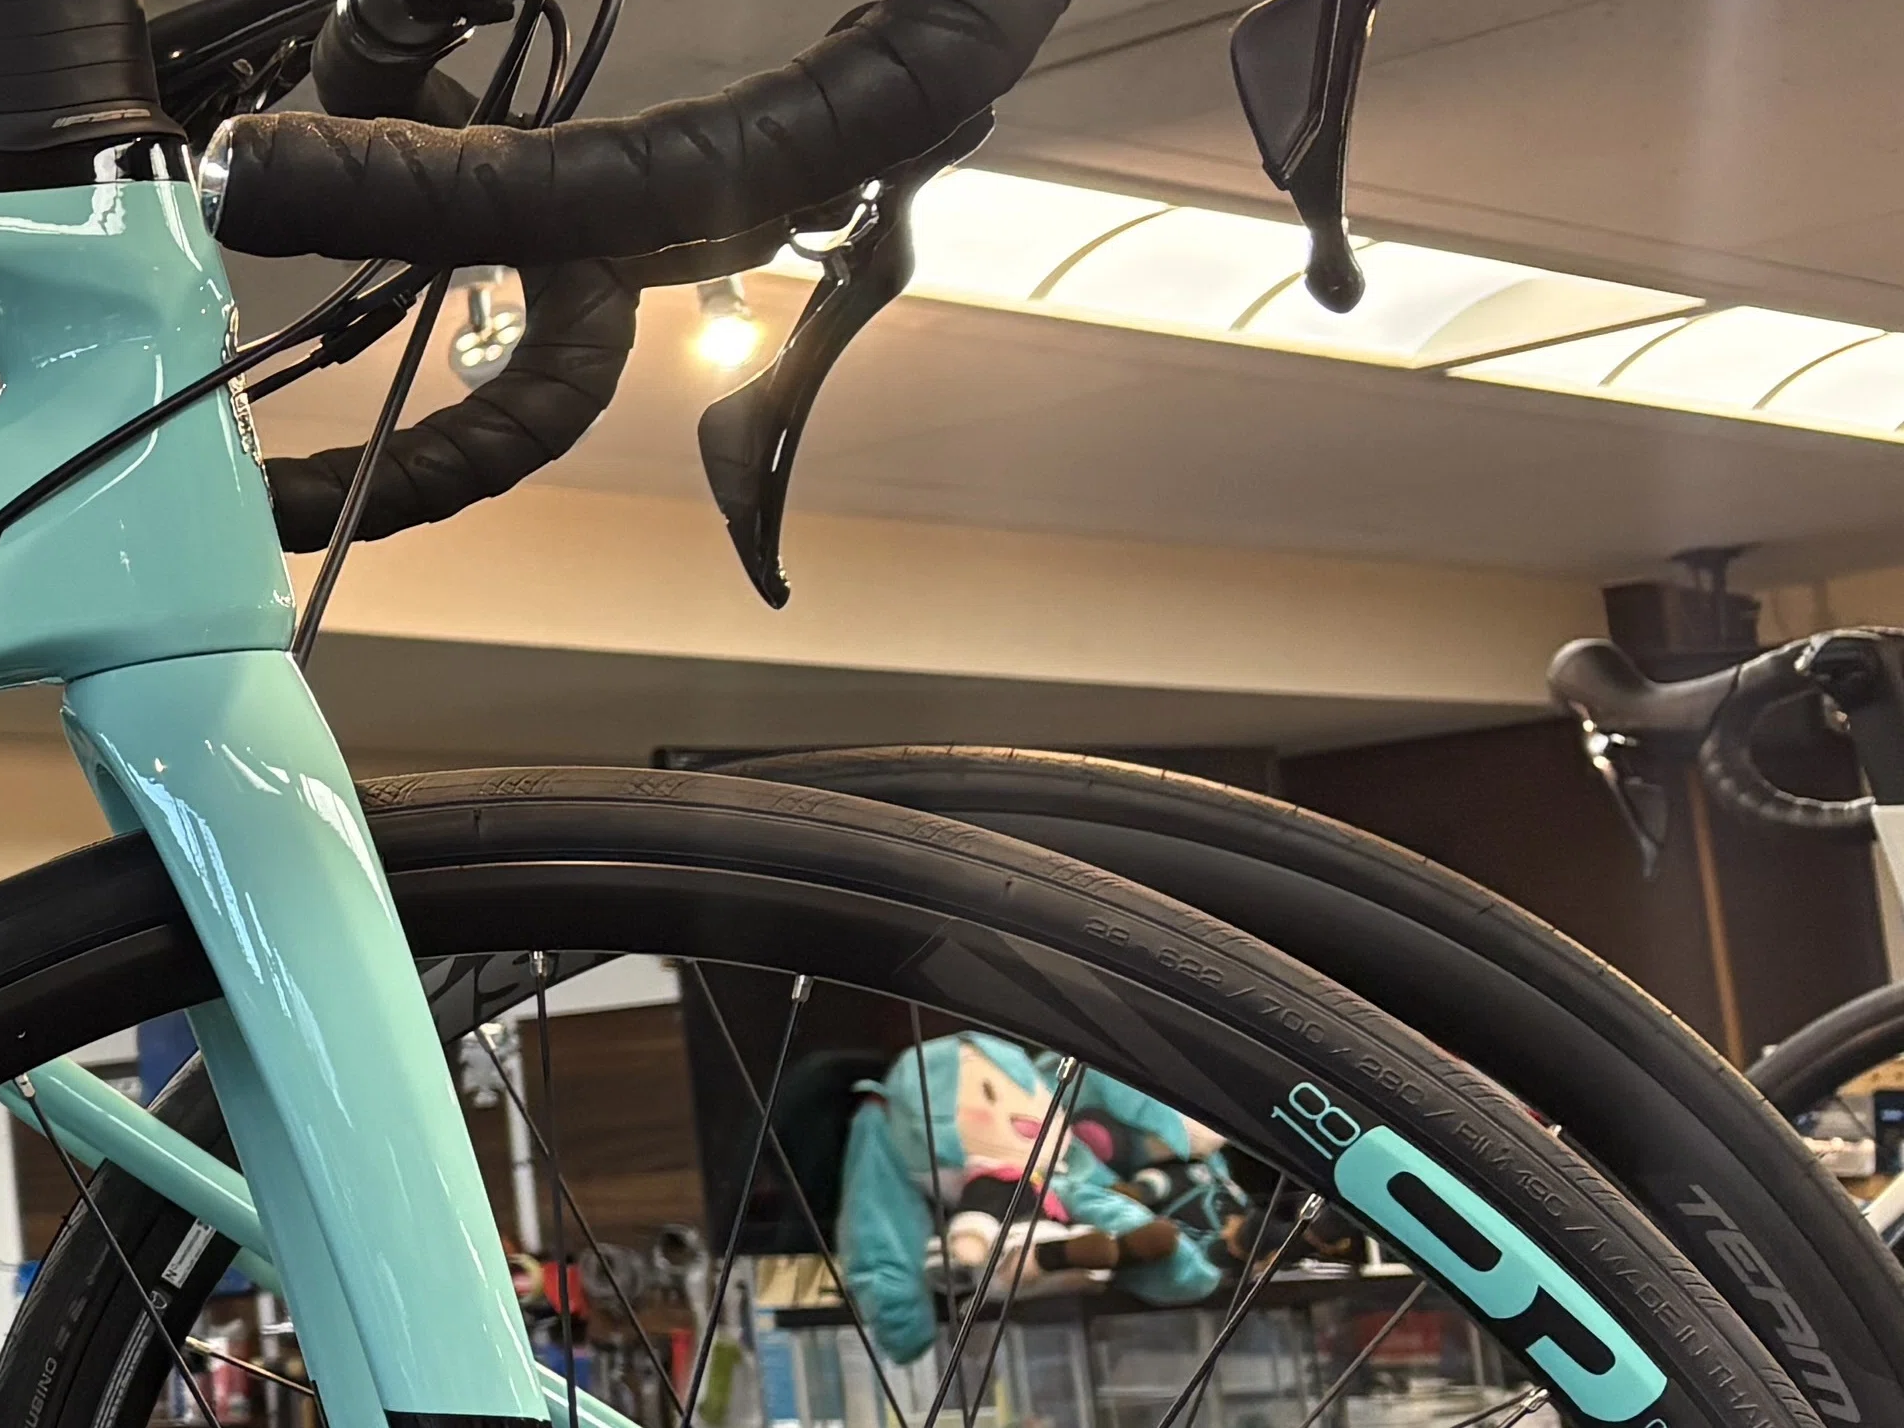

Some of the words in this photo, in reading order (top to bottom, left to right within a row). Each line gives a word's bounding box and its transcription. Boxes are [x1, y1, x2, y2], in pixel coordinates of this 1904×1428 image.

[1258, 996, 1324, 1056] 700
[1270, 1080, 1362, 1163] 18
[1678, 1182, 1863, 1426] TEAM
